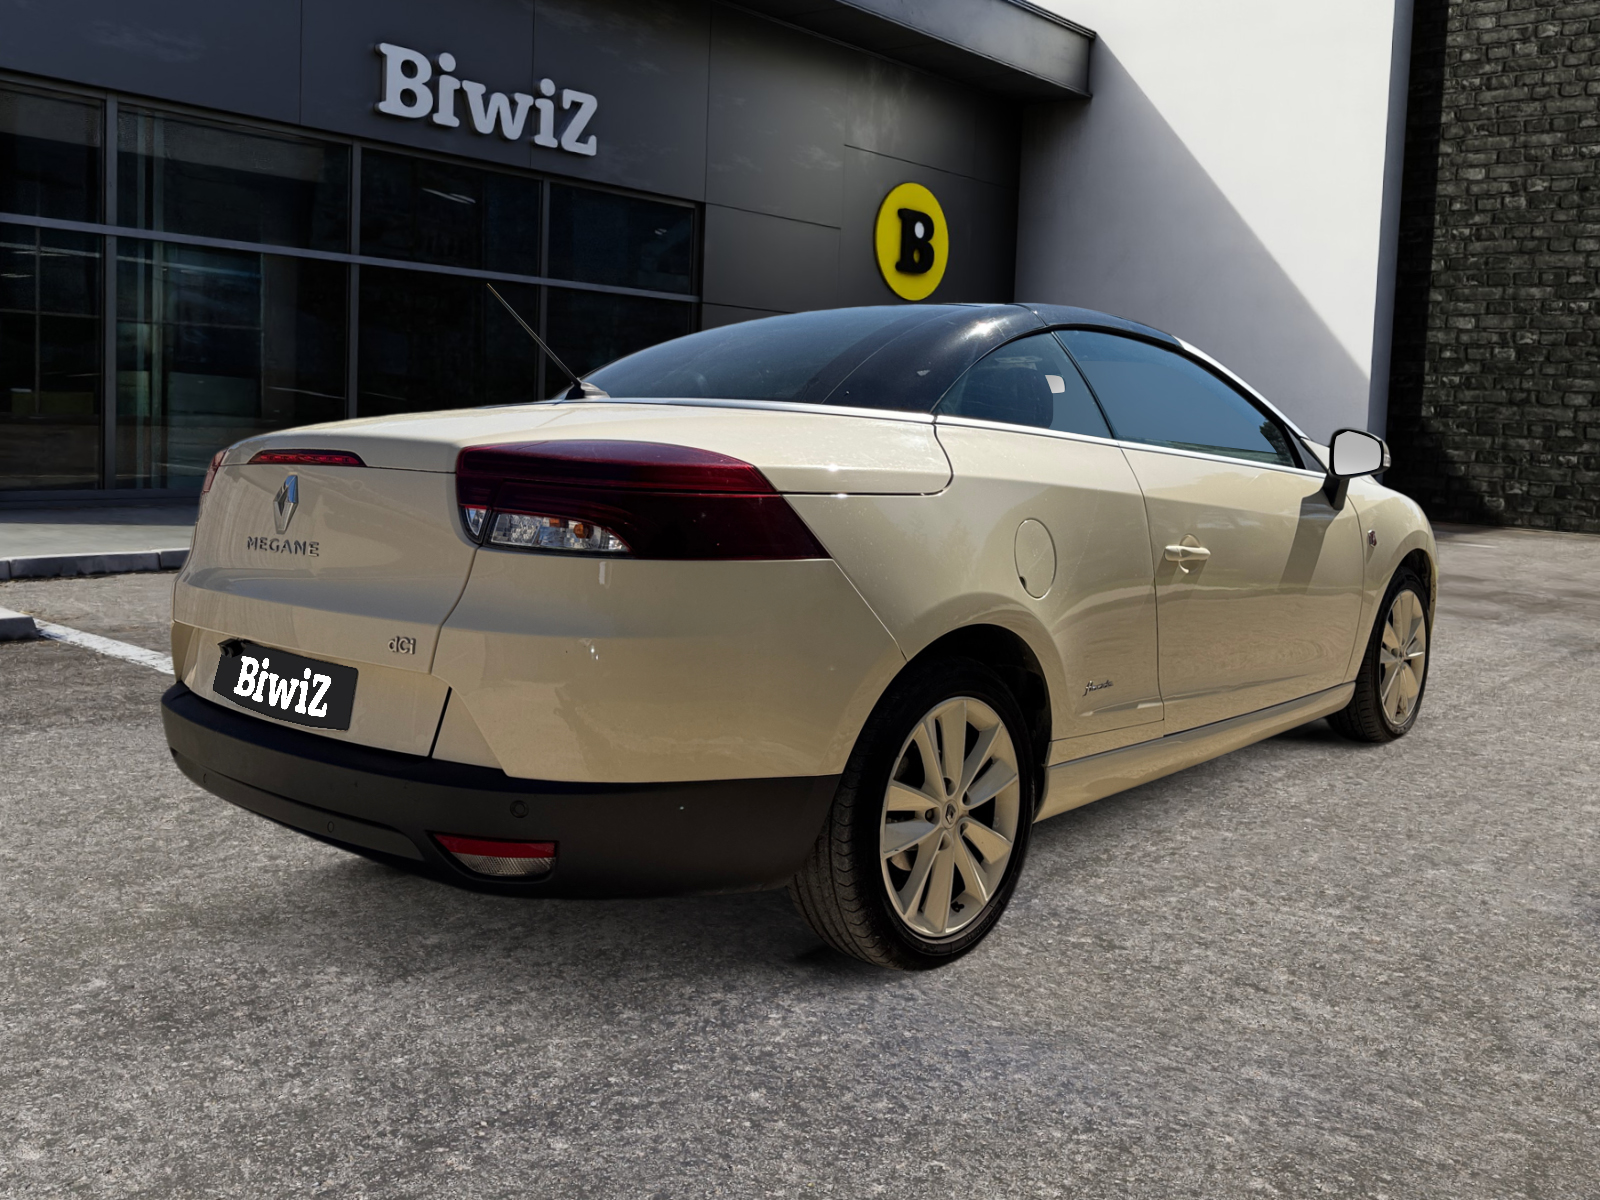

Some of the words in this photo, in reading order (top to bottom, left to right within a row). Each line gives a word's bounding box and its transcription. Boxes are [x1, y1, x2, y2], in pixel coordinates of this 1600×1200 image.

[895, 207, 935, 275] B
[247, 535, 320, 557] MEGANE
[387, 636, 417, 655] dCi
